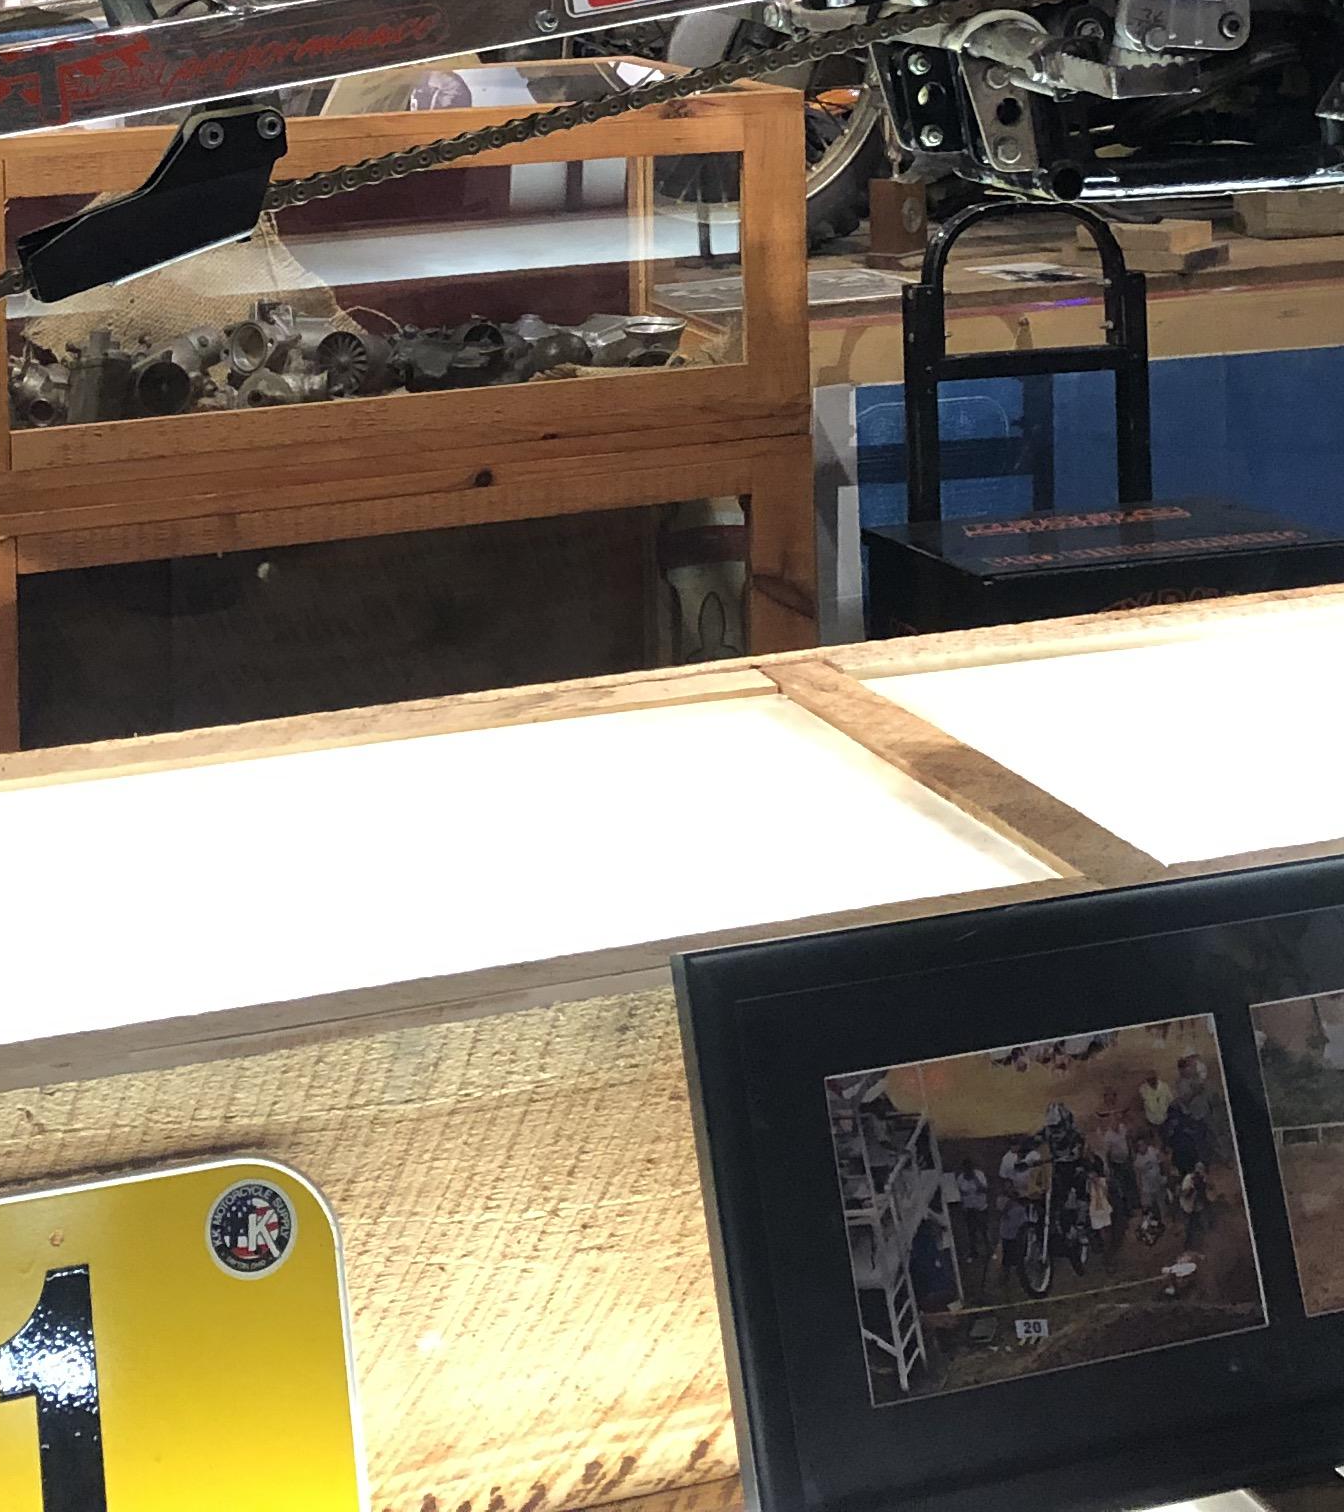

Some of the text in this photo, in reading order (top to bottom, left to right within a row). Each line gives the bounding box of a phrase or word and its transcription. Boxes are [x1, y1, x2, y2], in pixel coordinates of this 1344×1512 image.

[213, 1186, 273, 1226] MOTORCYCLE
[272, 1198, 291, 1240] SUPPLY
[1023, 1321, 1043, 1334] 20
